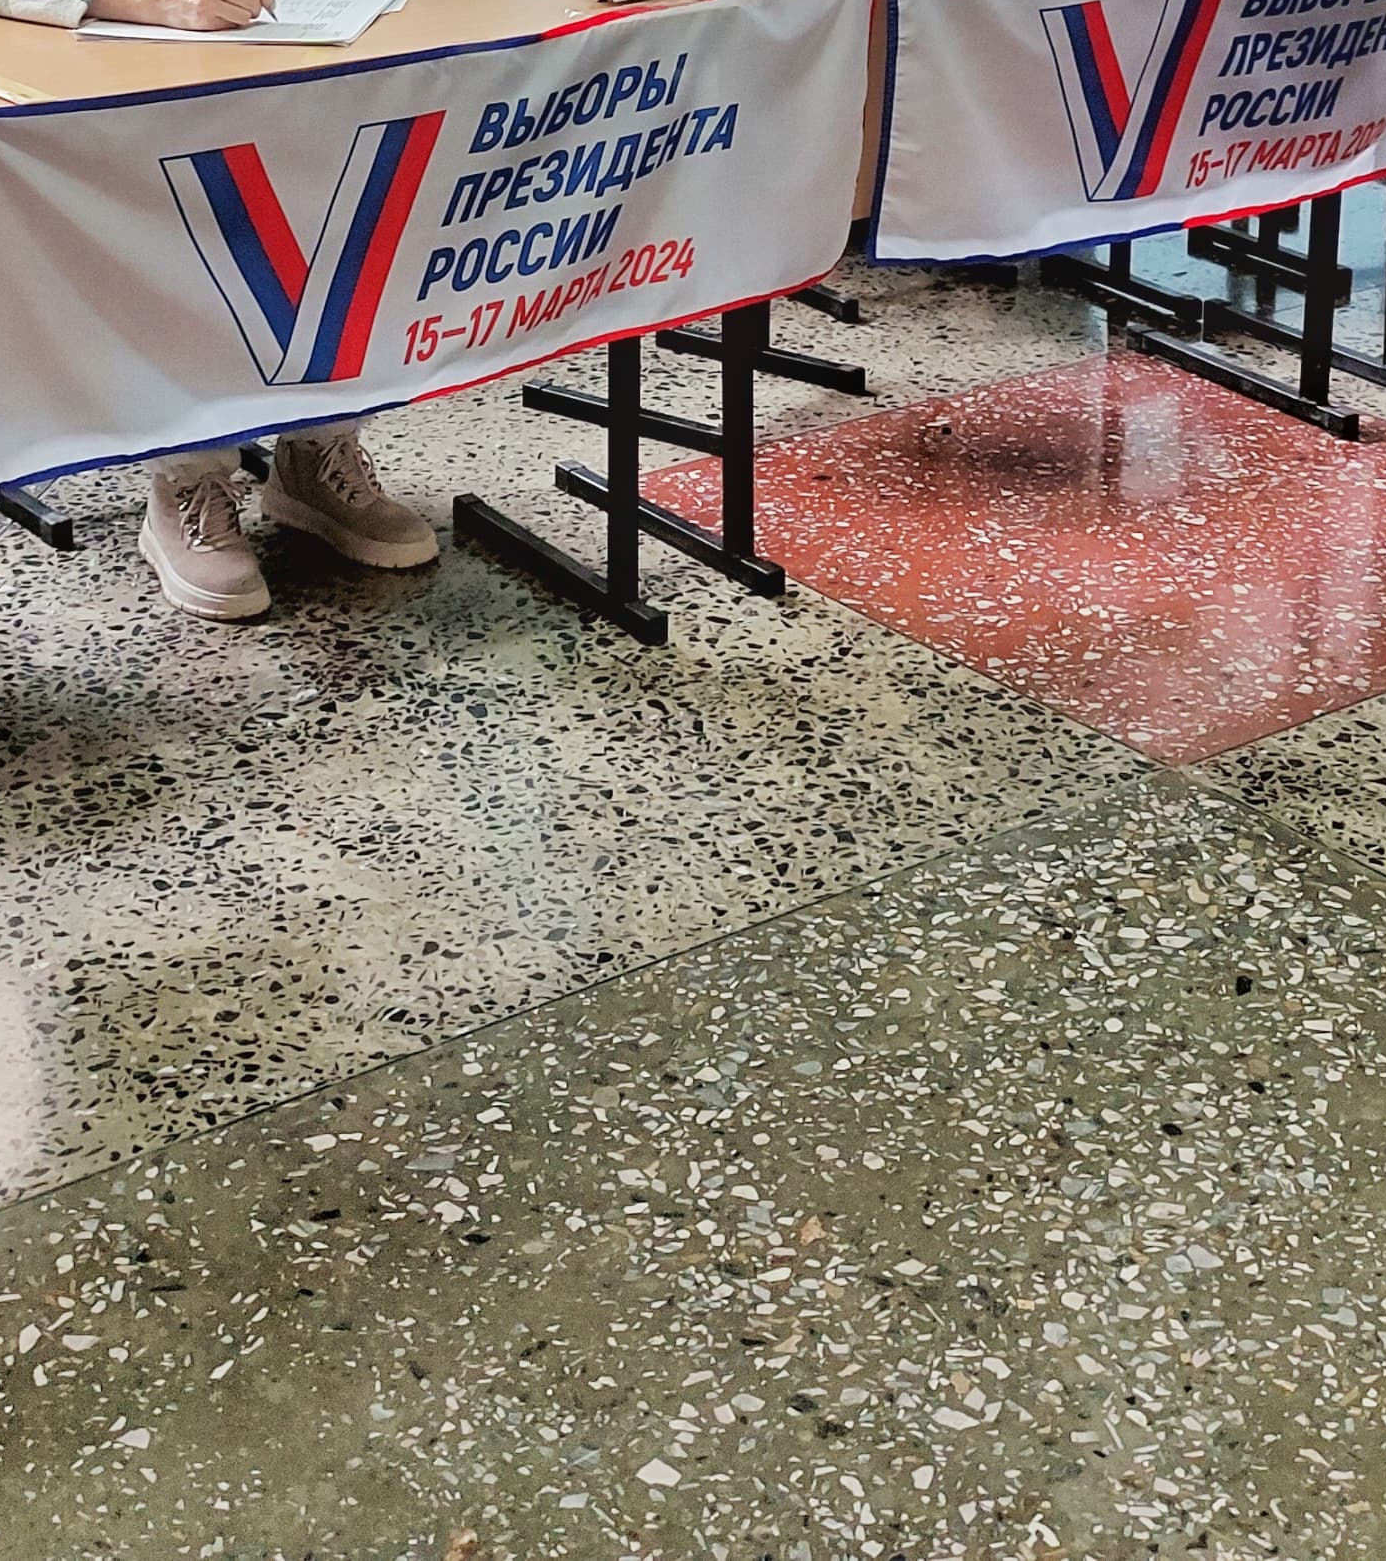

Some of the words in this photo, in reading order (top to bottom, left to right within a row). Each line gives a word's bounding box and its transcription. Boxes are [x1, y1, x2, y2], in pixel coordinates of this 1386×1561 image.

[468, 52, 689, 154] ВЫБОРЫ
[1198, 76, 1344, 137] РОССИИ
[1247, 129, 1343, 173] МАРТА
[440, 103, 739, 228] ПРЕЗИДЕНТА
[416, 203, 623, 302] РОССИИ
[505, 263, 610, 339] МАРТА
[608, 237, 695, 294] 2024
